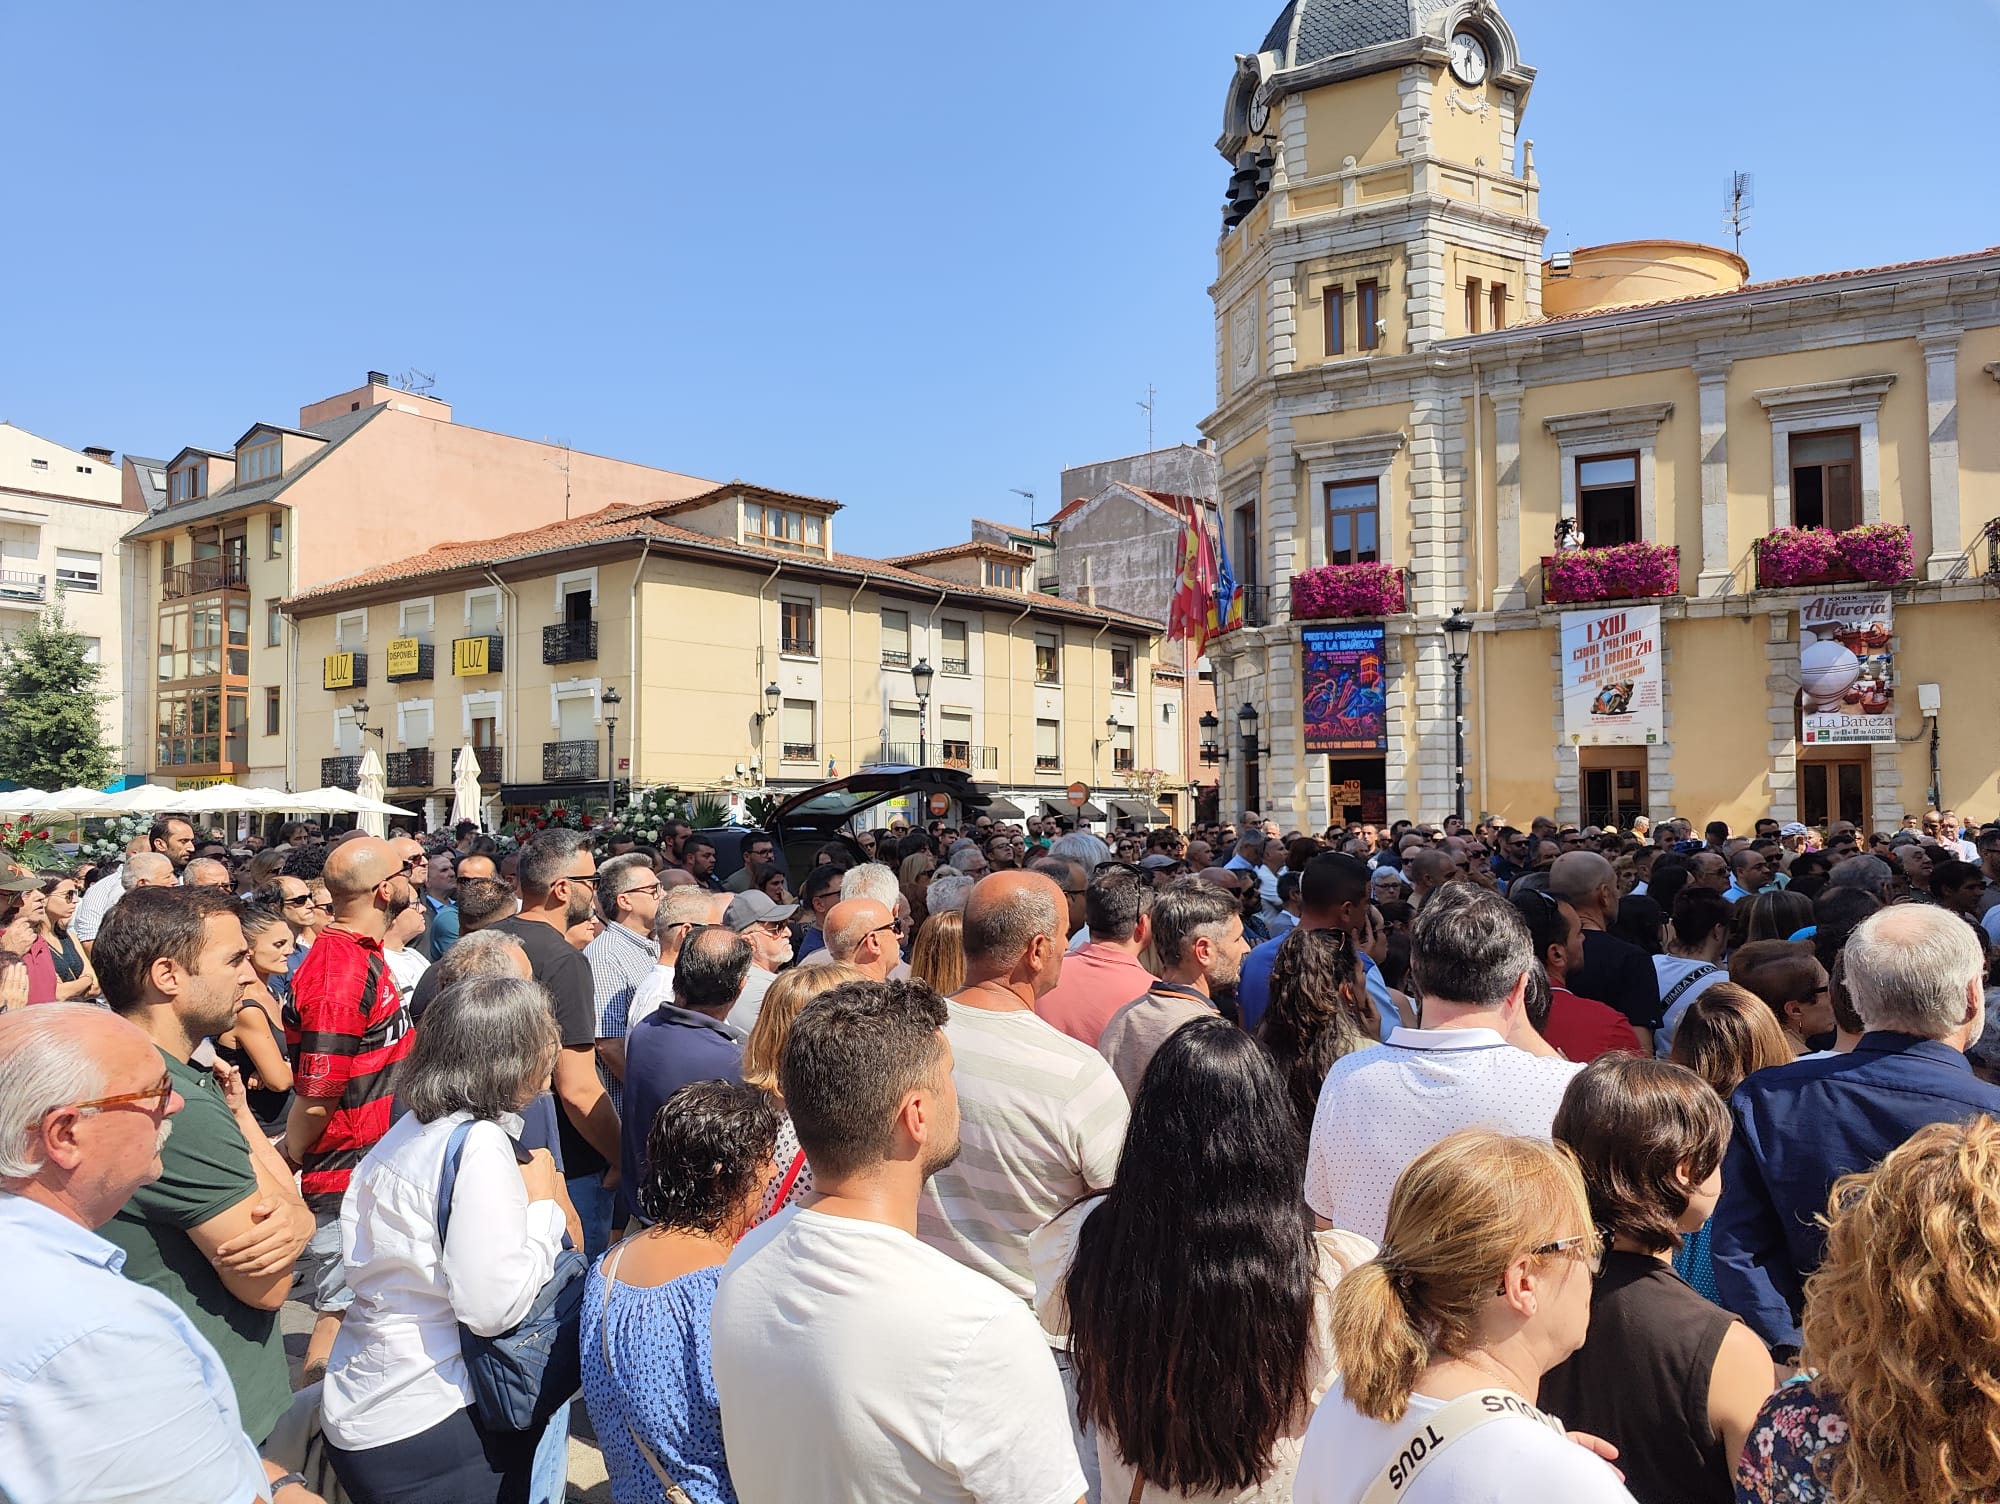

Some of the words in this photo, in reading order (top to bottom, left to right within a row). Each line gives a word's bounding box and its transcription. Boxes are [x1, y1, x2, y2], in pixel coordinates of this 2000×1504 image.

[1803, 598, 1888, 620] Alfarería
[392, 640, 413, 650] EDIFICIO
[1311, 641, 1324, 651] DE
[1326, 640, 1338, 651] LA
[389, 650, 417, 661] DISPONIBLE
[462, 639, 483, 668] LUZ
[331, 654, 348, 681] LUZ
[1818, 716, 1835, 727] La
[1840, 715, 1893, 727] Bañeza
[1344, 780, 1360, 789] NO
[1389, 1424, 1444, 1490] TOUS
